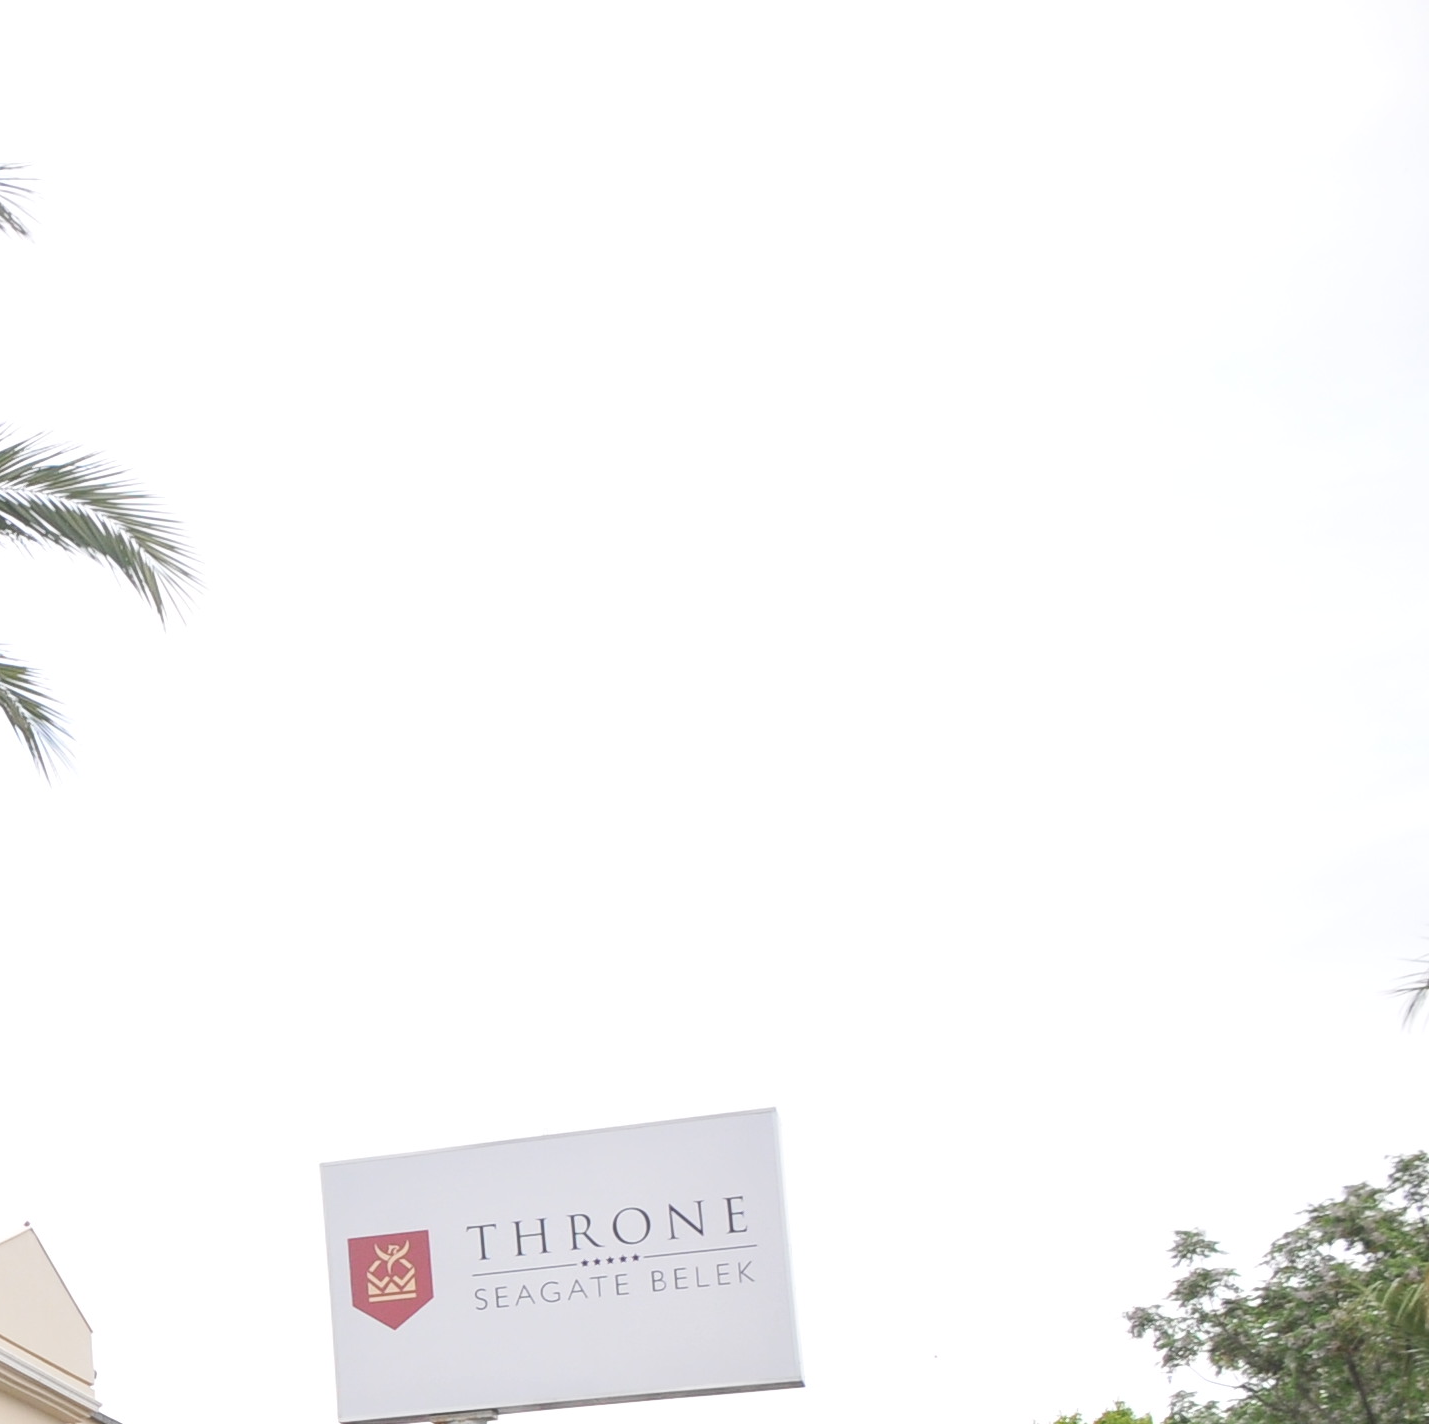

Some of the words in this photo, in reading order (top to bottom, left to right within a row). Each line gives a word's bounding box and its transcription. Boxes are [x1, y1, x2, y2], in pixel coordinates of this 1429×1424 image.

[466, 1195, 748, 1261] THRONE
[474, 1273, 630, 1311] SEAGATE
[651, 1260, 756, 1293] BELEK
